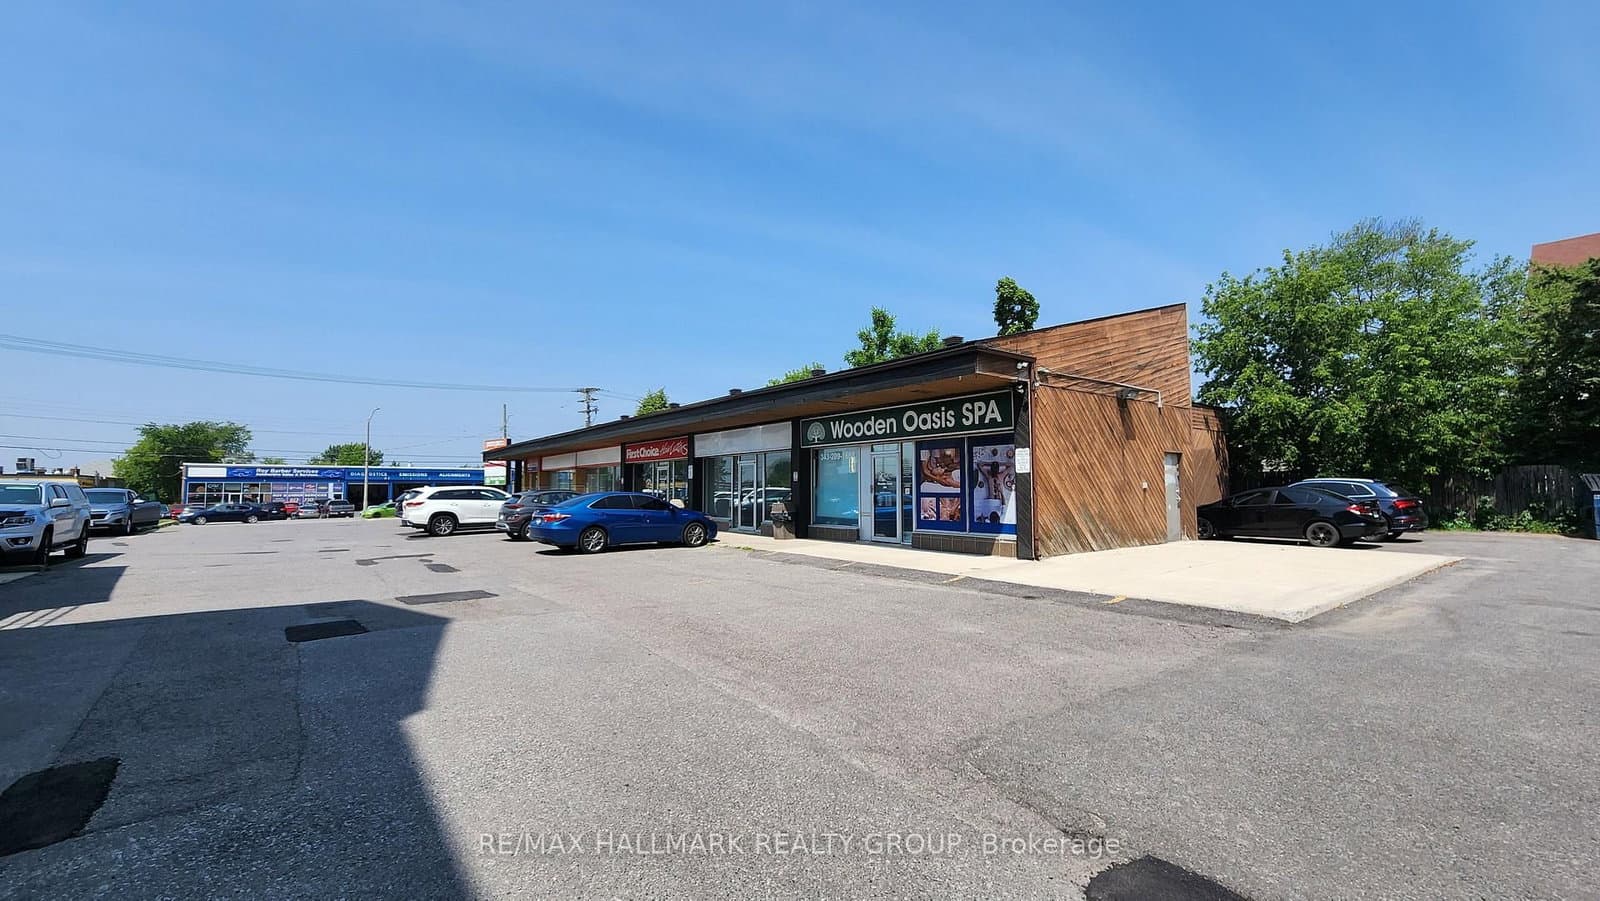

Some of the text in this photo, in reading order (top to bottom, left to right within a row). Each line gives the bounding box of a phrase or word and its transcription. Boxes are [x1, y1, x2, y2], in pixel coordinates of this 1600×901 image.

[830, 399, 1003, 440] Wooden Oasis SPA
[626, 448, 640, 459] First
[639, 446, 660, 458] Choice
